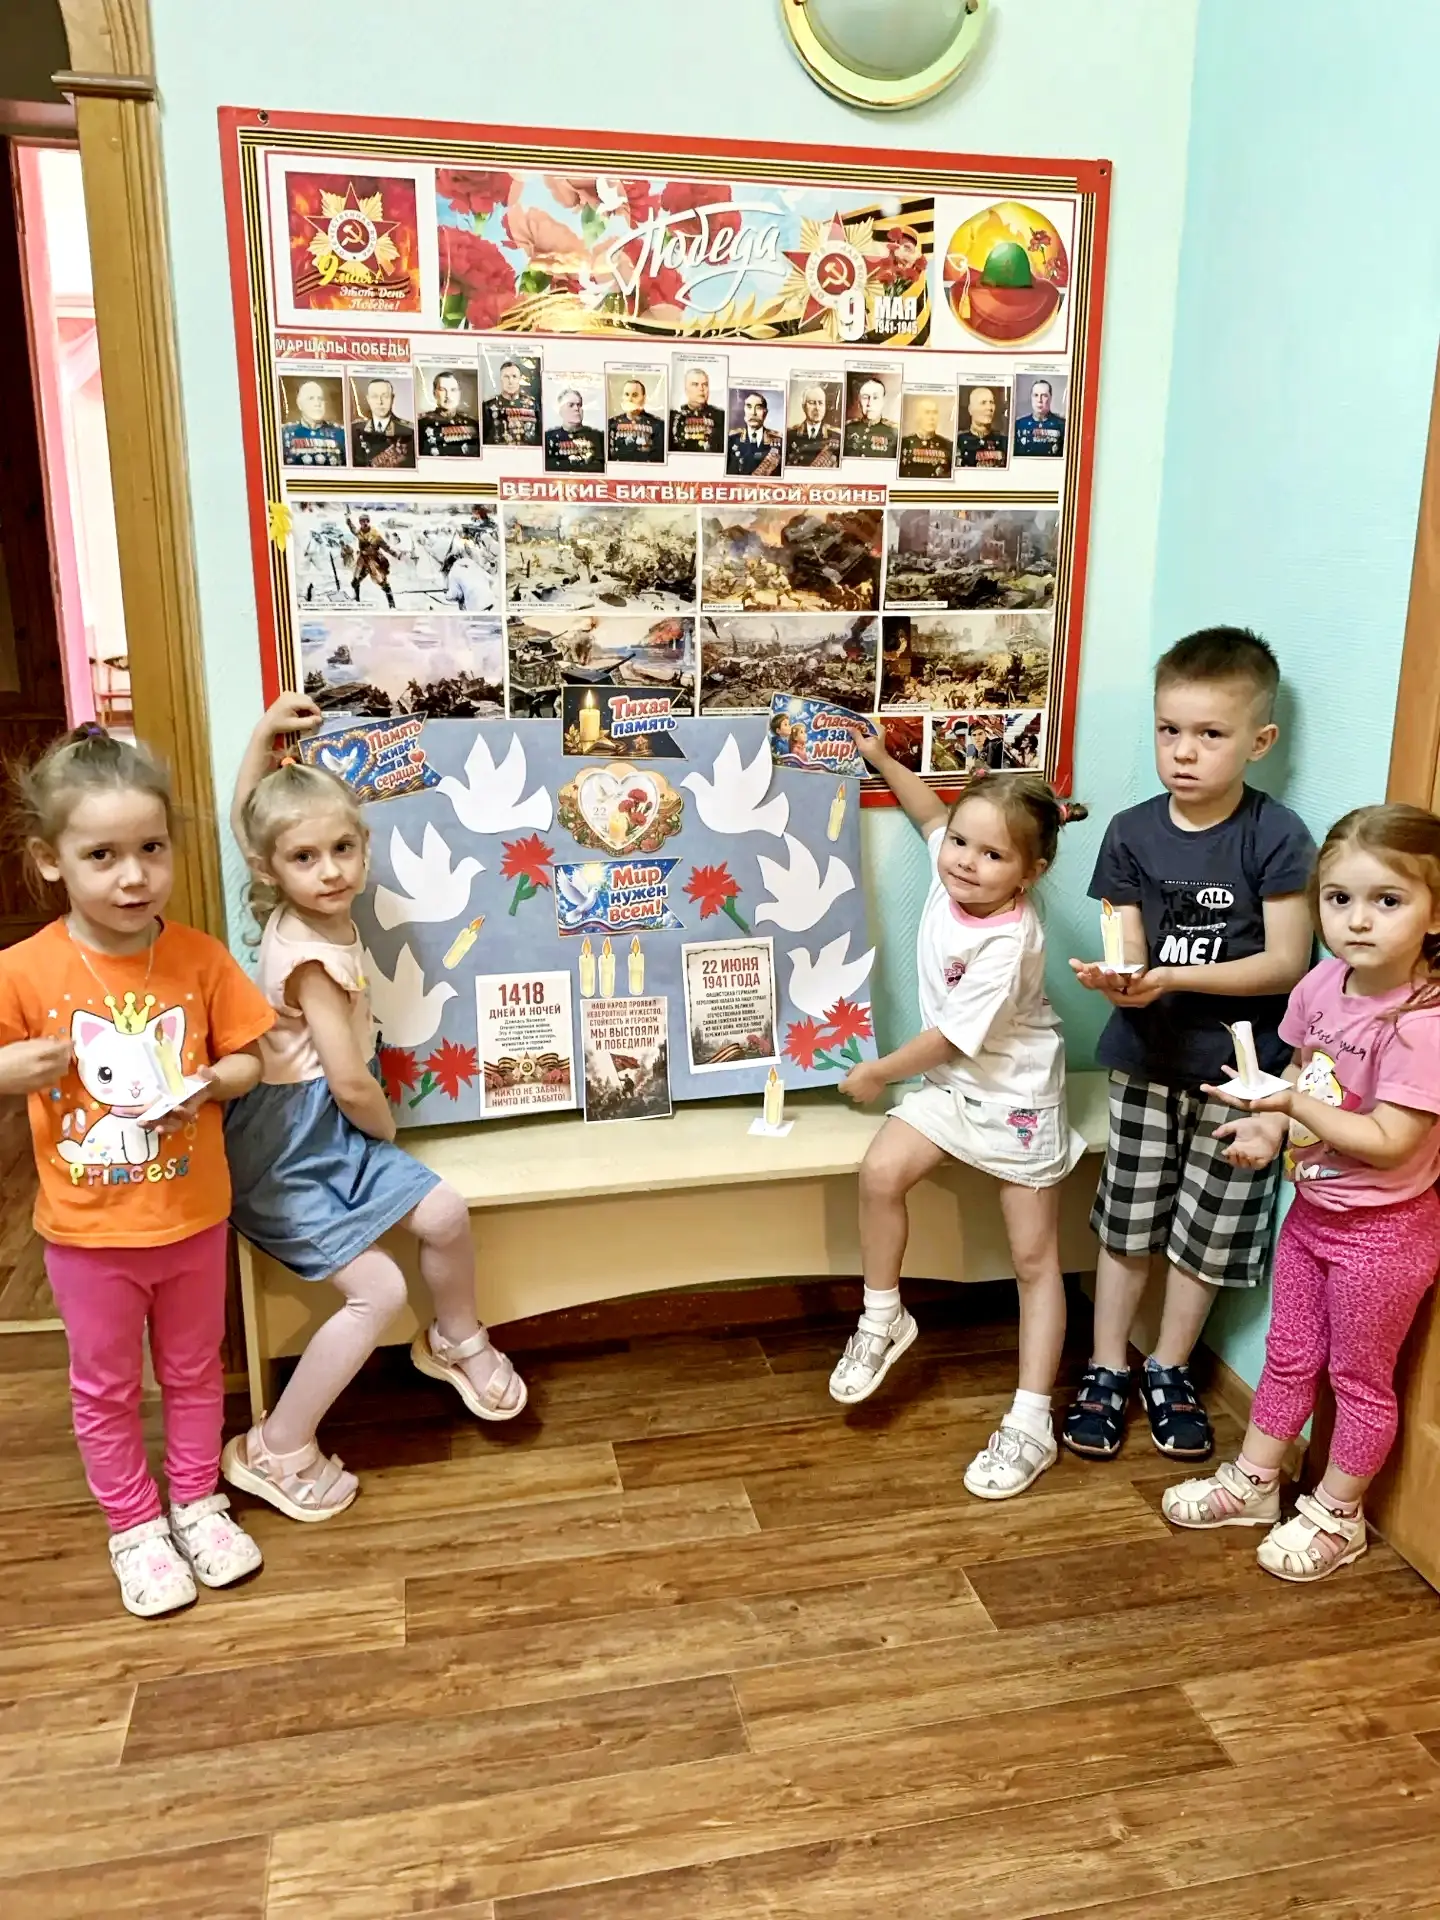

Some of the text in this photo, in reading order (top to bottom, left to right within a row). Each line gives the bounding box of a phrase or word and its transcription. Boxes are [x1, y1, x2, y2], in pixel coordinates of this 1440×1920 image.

[607, 200, 786, 316] Победа
[318, 254, 338, 285] 9
[379, 287, 406, 299] День
[837, 290, 917, 341] 9 МАЯ
[875, 320, 918, 335] 1941-1945
[275, 338, 409, 357] МАРШАЛЫ ПОБЕДЫ
[502, 482, 608, 499] ВЕЛИКИЕ
[615, 484, 696, 500] БИТВЫ
[610, 697, 669, 719] Тихая
[613, 718, 676, 736] память
[828, 729, 845, 741] за
[368, 721, 421, 752] Память
[813, 740, 857, 761] мир!
[376, 764, 422, 787] сердцах
[593, 806, 607, 816] 22
[613, 867, 660, 888] Мир
[610, 885, 667, 905] нужен
[1201, 891, 1230, 904] ALL
[609, 899, 661, 922] всем!
[1159, 935, 1223, 965] ME!
[702, 956, 759, 974] 22 ИЮНЯ
[702, 972, 760, 989] 1941 ГОДА
[498, 981, 544, 1006] 1418
[489, 1003, 561, 1020] ДНЕЙ И НОЧЕЙ
[607, 1001, 627, 1009] НАРОД
[589, 1018, 623, 1026] СТОЙКОСТЬ
[590, 1025, 659, 1039] МЫ ВЫСТОЯЛИ
[596, 1037, 655, 1050] И ПОБЕДИЛИ!
[492, 1093, 566, 1107] НИЧТО НЕ ЗАБЫТО!
[494, 1088, 521, 1097] НИКТО
[524, 1086, 532, 1095] НЕ
[69, 1156, 189, 1185] Princess
